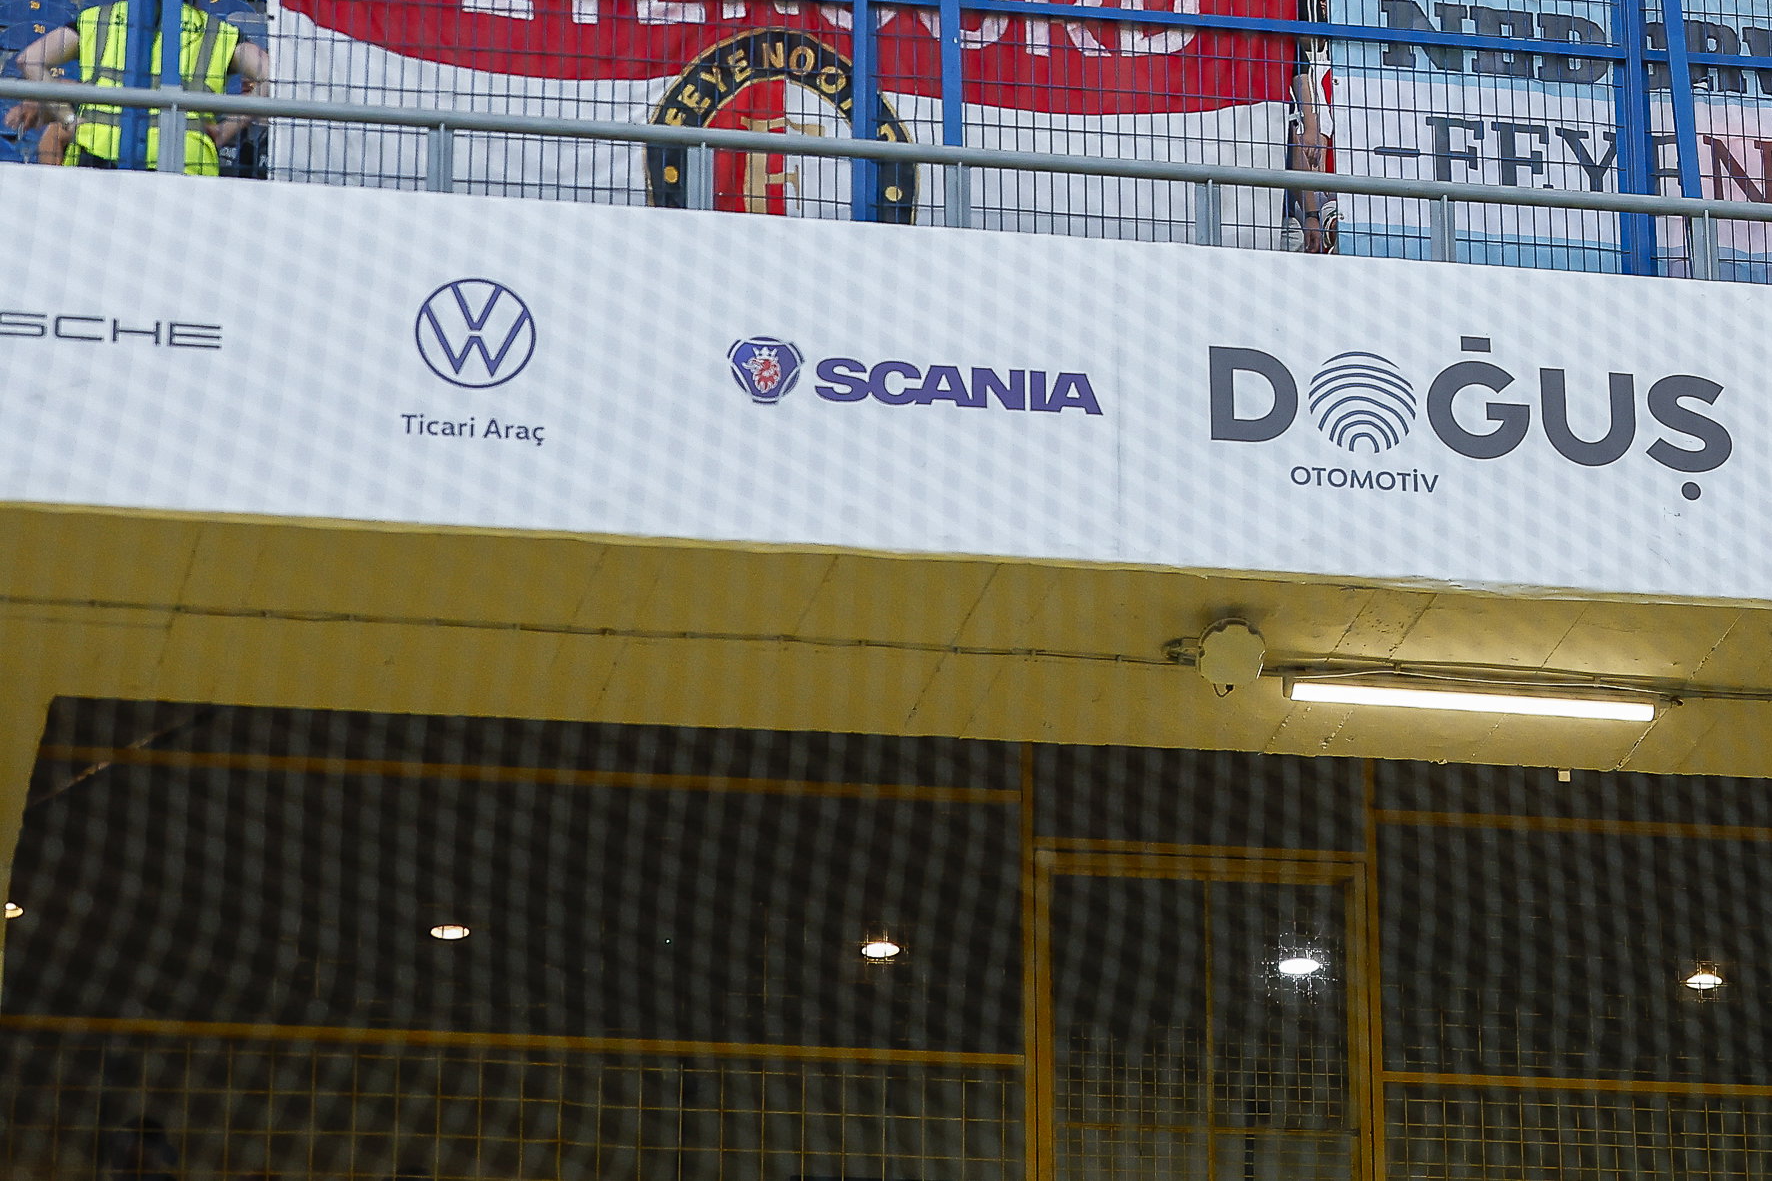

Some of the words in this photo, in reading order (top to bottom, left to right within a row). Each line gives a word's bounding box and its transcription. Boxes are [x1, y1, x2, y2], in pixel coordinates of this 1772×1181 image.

[664, 40, 898, 143] FEYENOO
[815, 356, 1105, 417] SCANIA
[401, 413, 477, 440] Ticari
[482, 418, 547, 446] Araç
